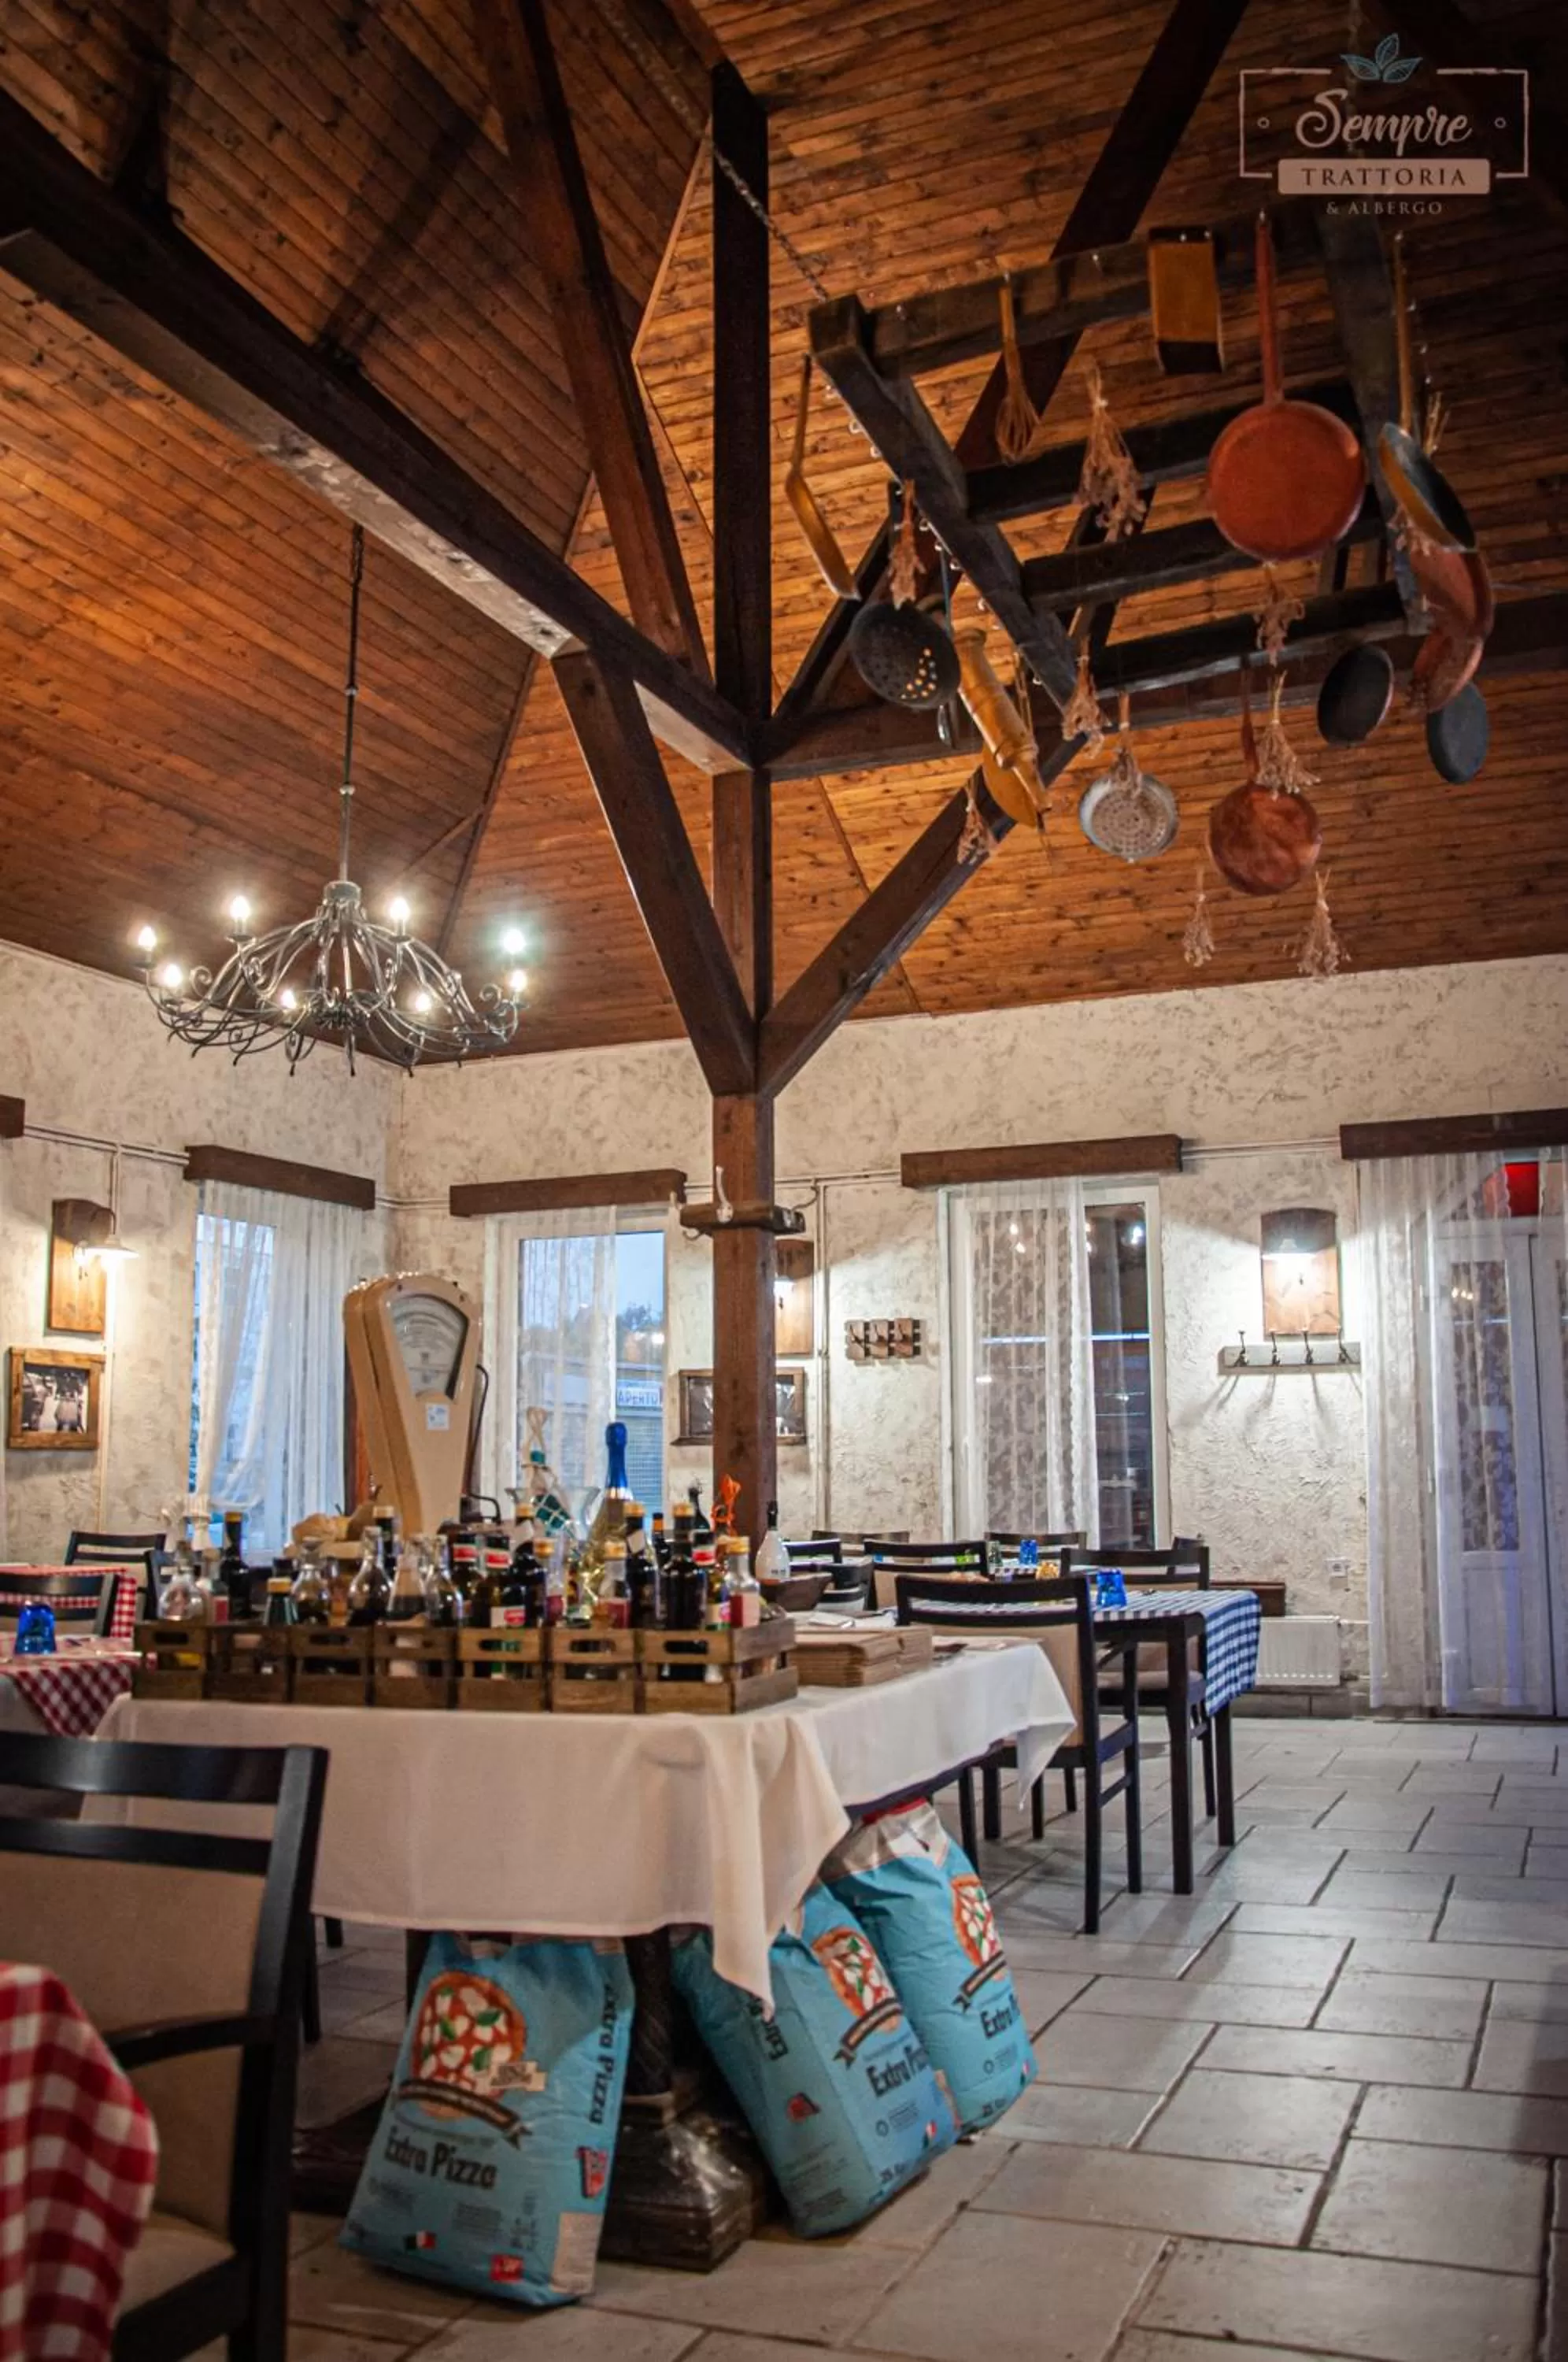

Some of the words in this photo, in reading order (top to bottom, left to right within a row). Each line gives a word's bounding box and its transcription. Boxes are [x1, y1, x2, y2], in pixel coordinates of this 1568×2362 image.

[590, 2055, 615, 2120] Pizza
[867, 2058, 911, 2097] Extra
[384, 2126, 427, 2173] Extra
[431, 2142, 497, 2190] Pizza
